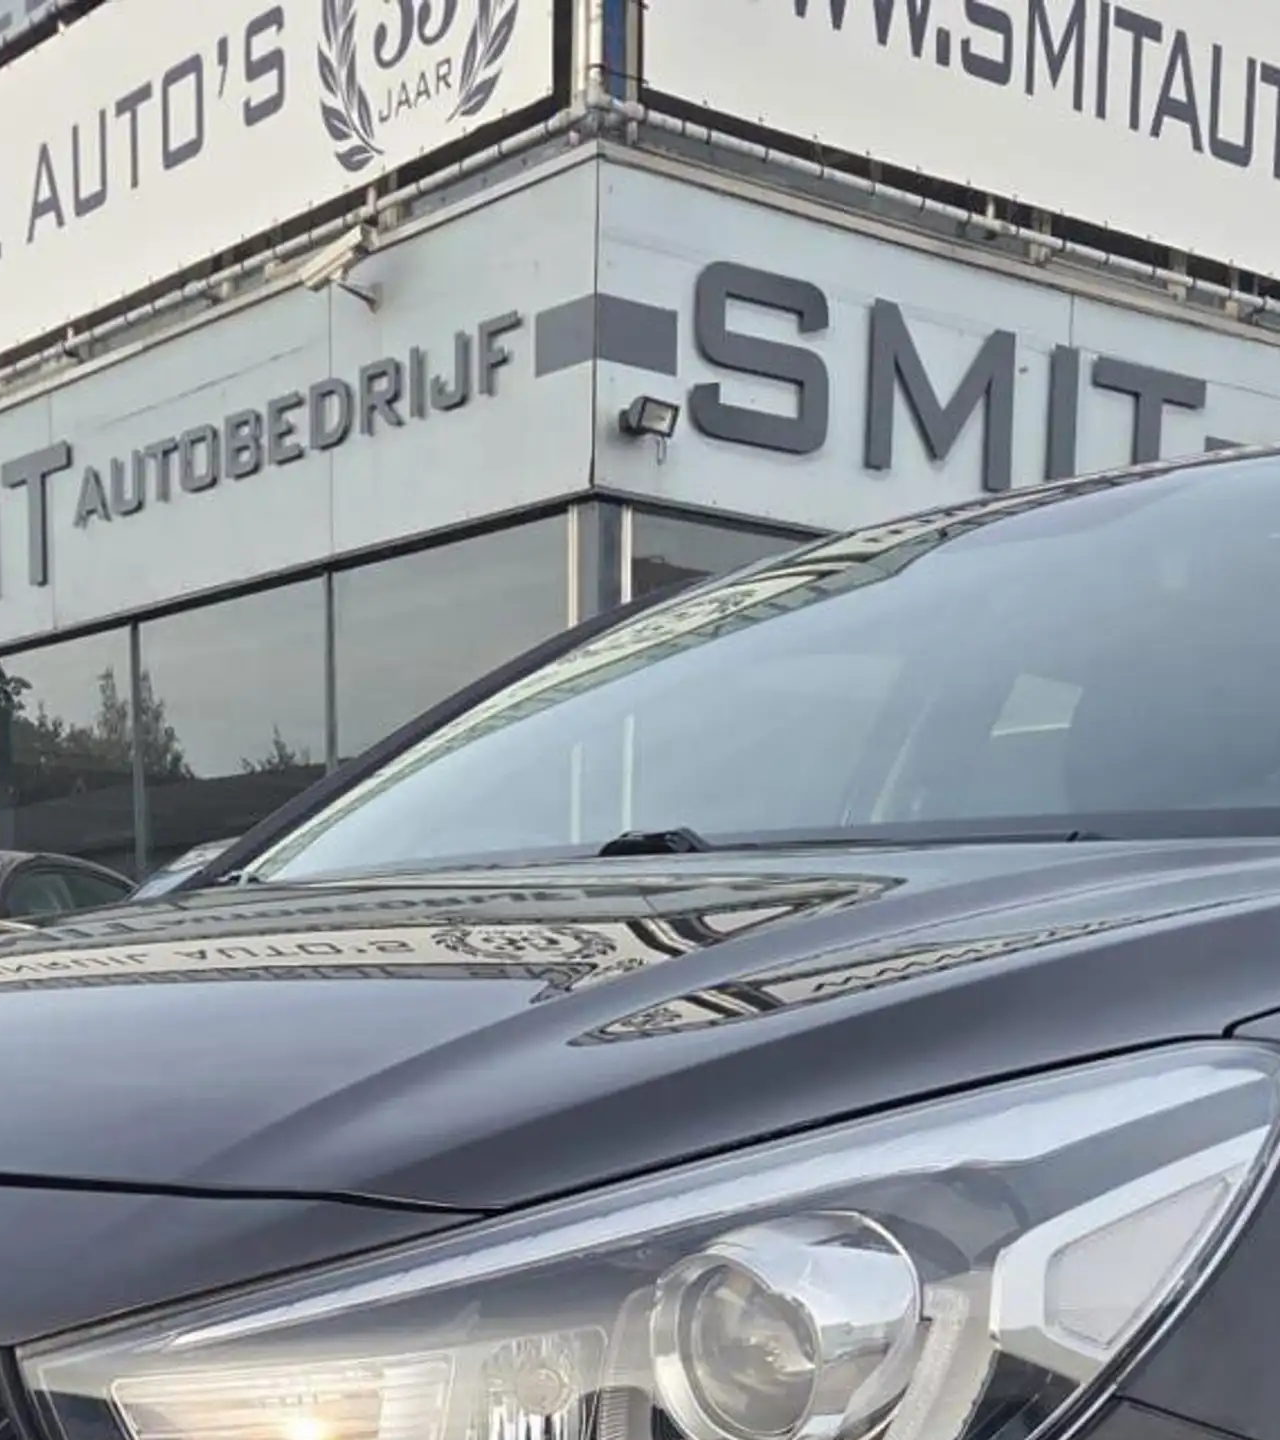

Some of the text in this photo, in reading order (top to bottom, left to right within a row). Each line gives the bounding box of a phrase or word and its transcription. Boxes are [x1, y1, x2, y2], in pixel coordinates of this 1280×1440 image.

[26, 5, 287, 244] AUTO'S
[378, 57, 453, 123] JAAR
[73, 310, 523, 529] AUTOBEDRIJF
[687, 260, 1207, 492] SMIT
